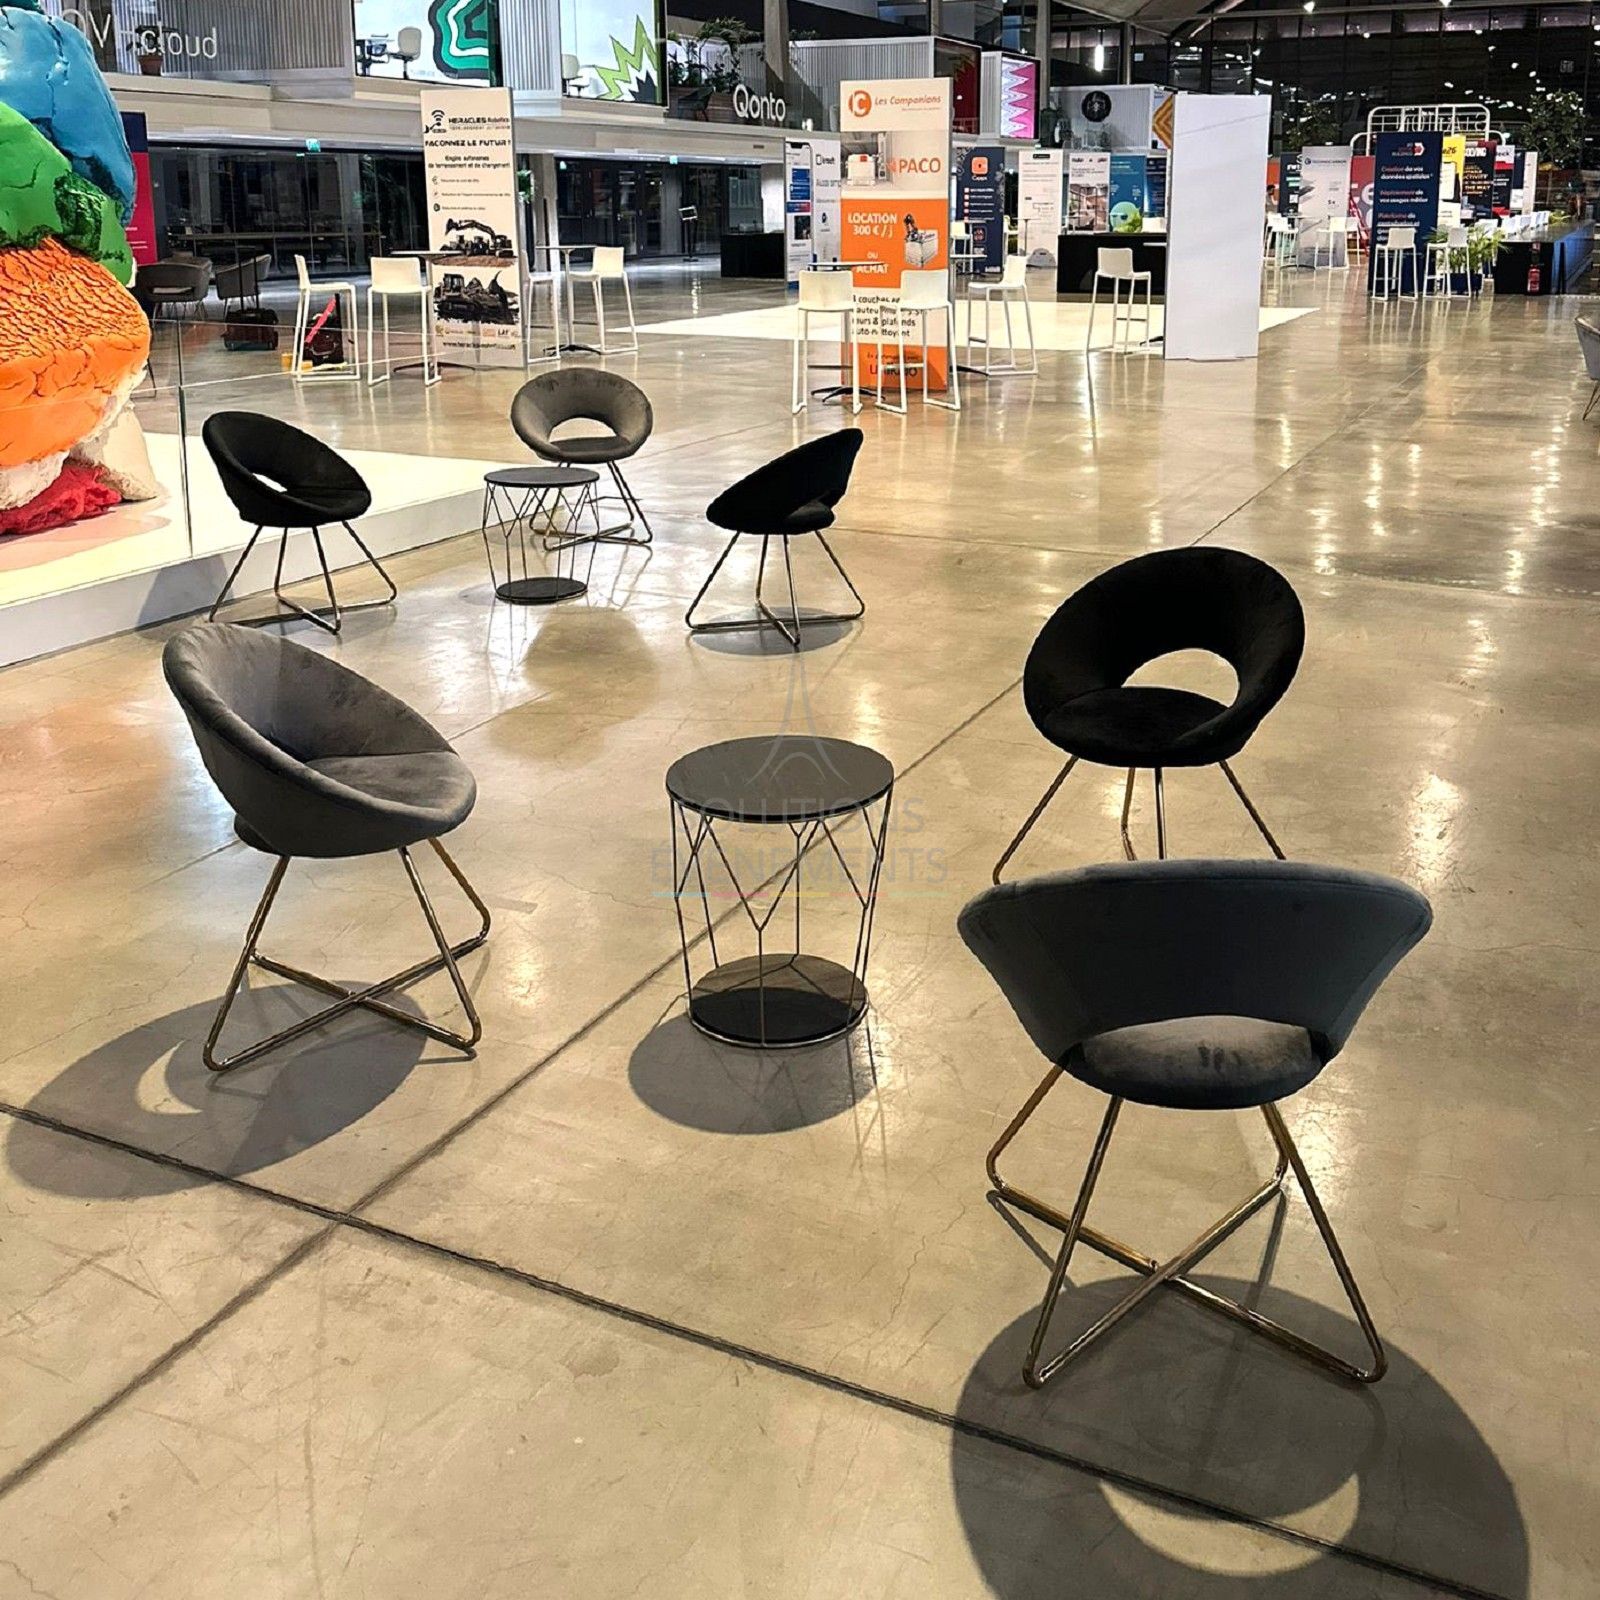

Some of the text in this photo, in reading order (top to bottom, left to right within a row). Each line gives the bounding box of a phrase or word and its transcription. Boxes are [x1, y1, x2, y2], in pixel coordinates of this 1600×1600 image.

[733, 84, 786, 122] Qonto
[899, 157, 942, 173] PACO
[847, 212, 898, 224] LOCATION
[853, 224, 871, 236] 300
[872, 224, 880, 236] €
[856, 265, 888, 274] ACHAT
[881, 318, 916, 327] plafnds
